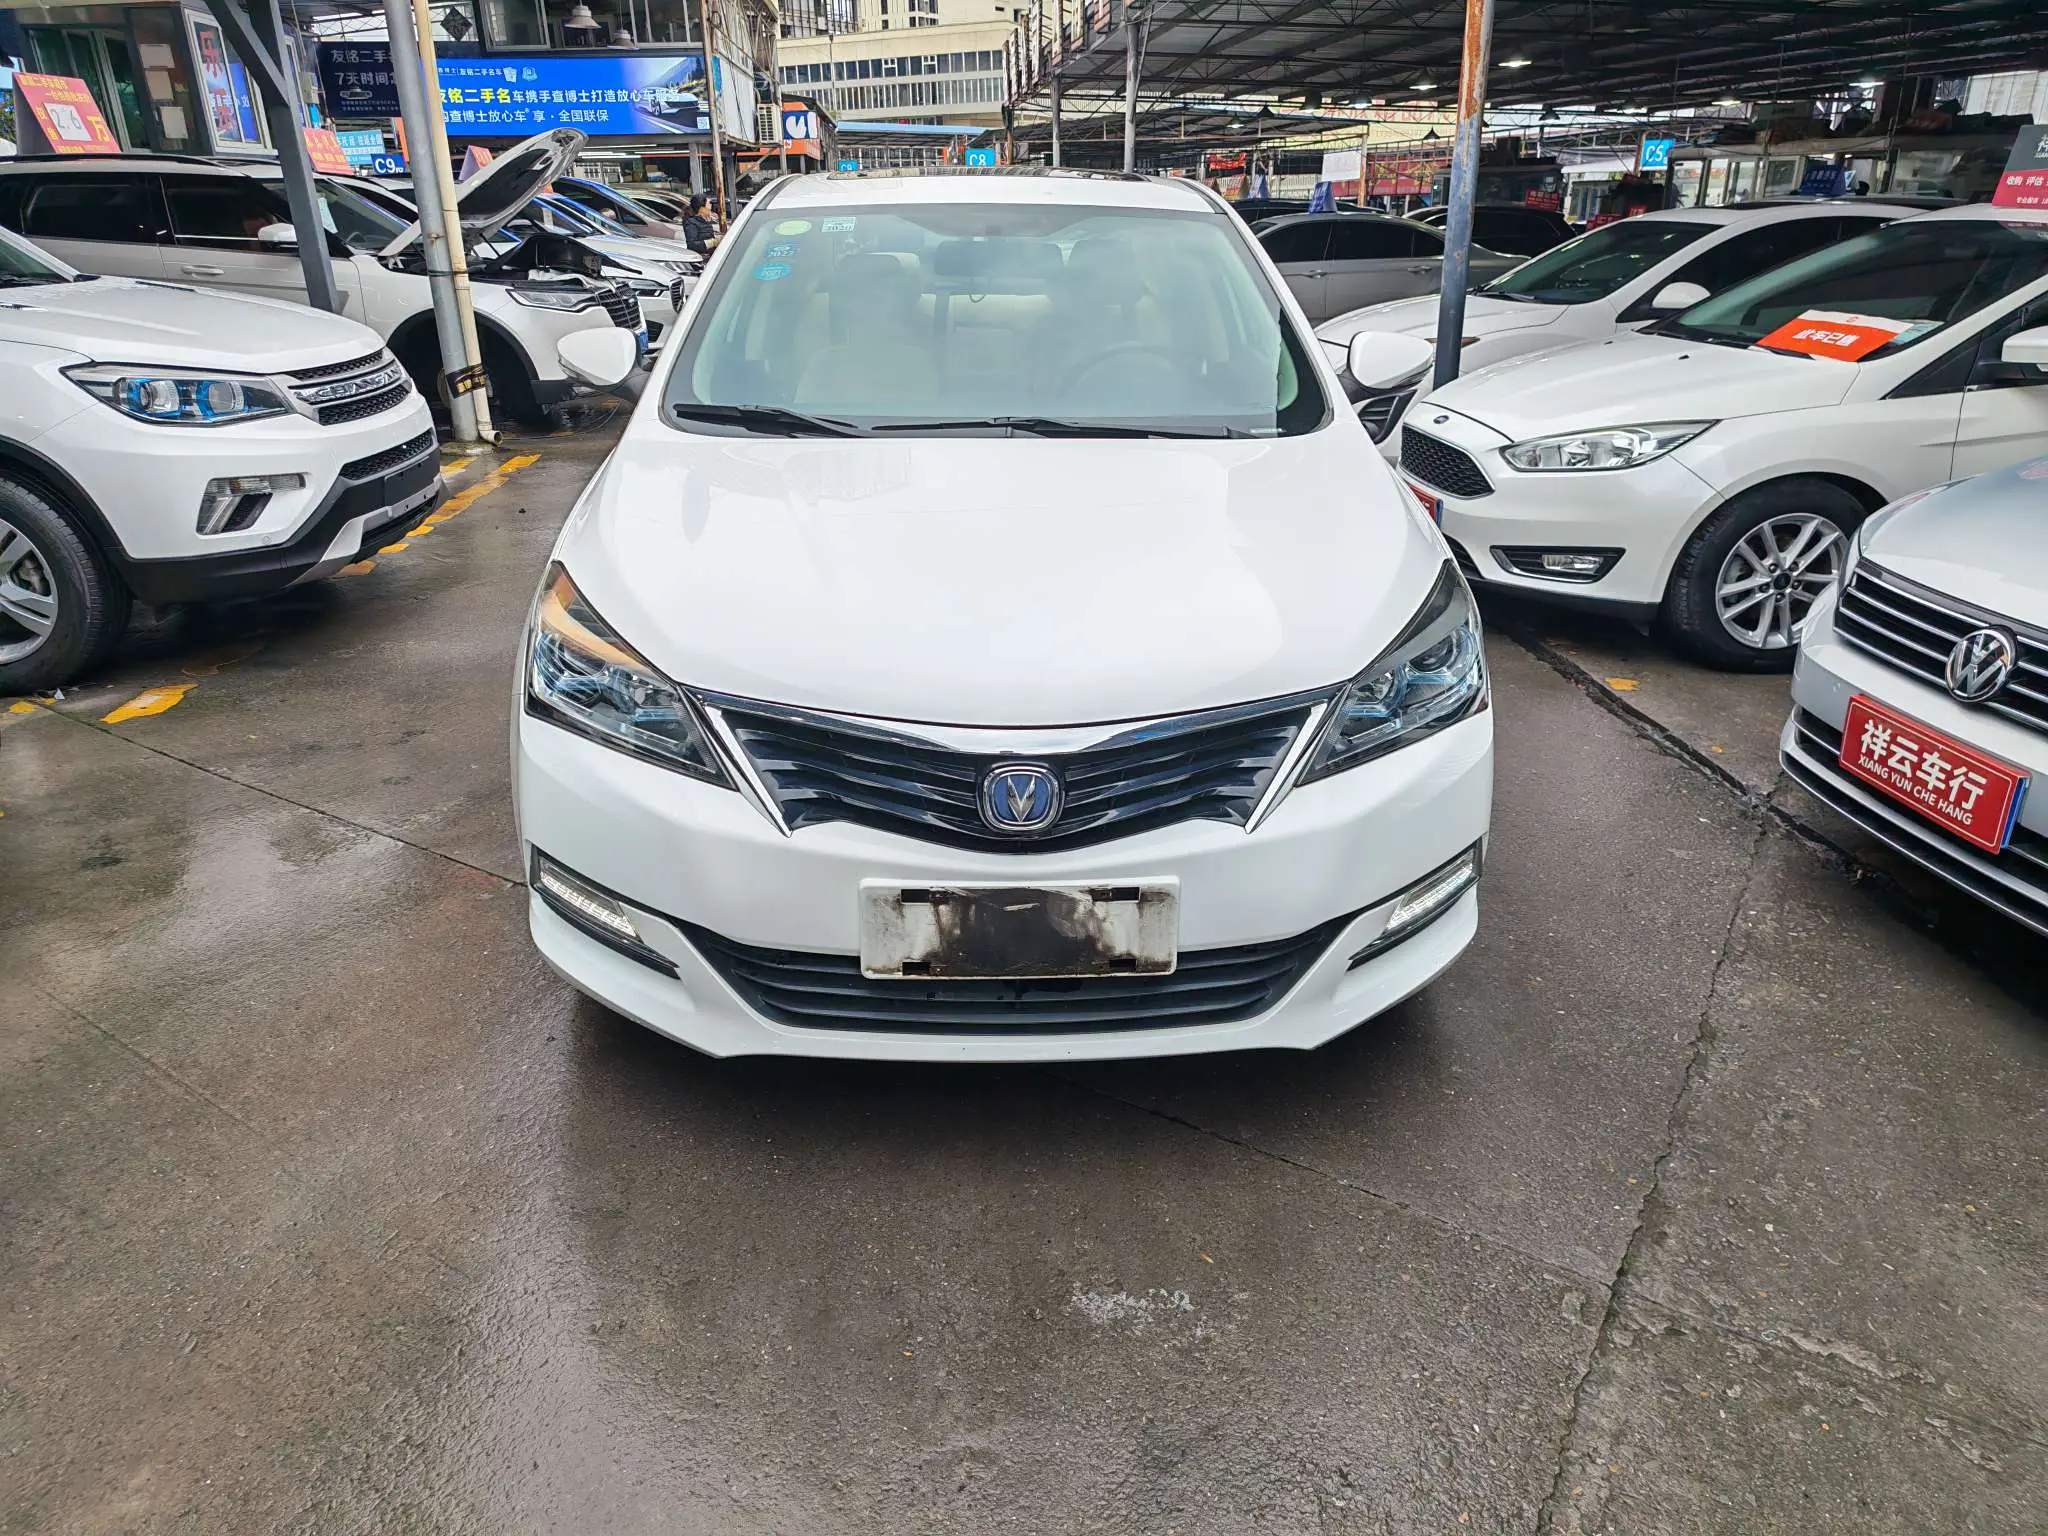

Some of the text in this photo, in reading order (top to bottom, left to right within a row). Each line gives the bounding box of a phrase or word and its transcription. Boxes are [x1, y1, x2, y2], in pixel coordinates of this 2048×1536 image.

[86, 115, 110, 142] 万
[969, 154, 987, 166] C8
[1645, 145, 1664, 163] C5
[375, 157, 396, 174] C9
[1860, 719, 1988, 810] 祥云车行
[1858, 755, 1973, 826] XIANG YUN CHE HANG
